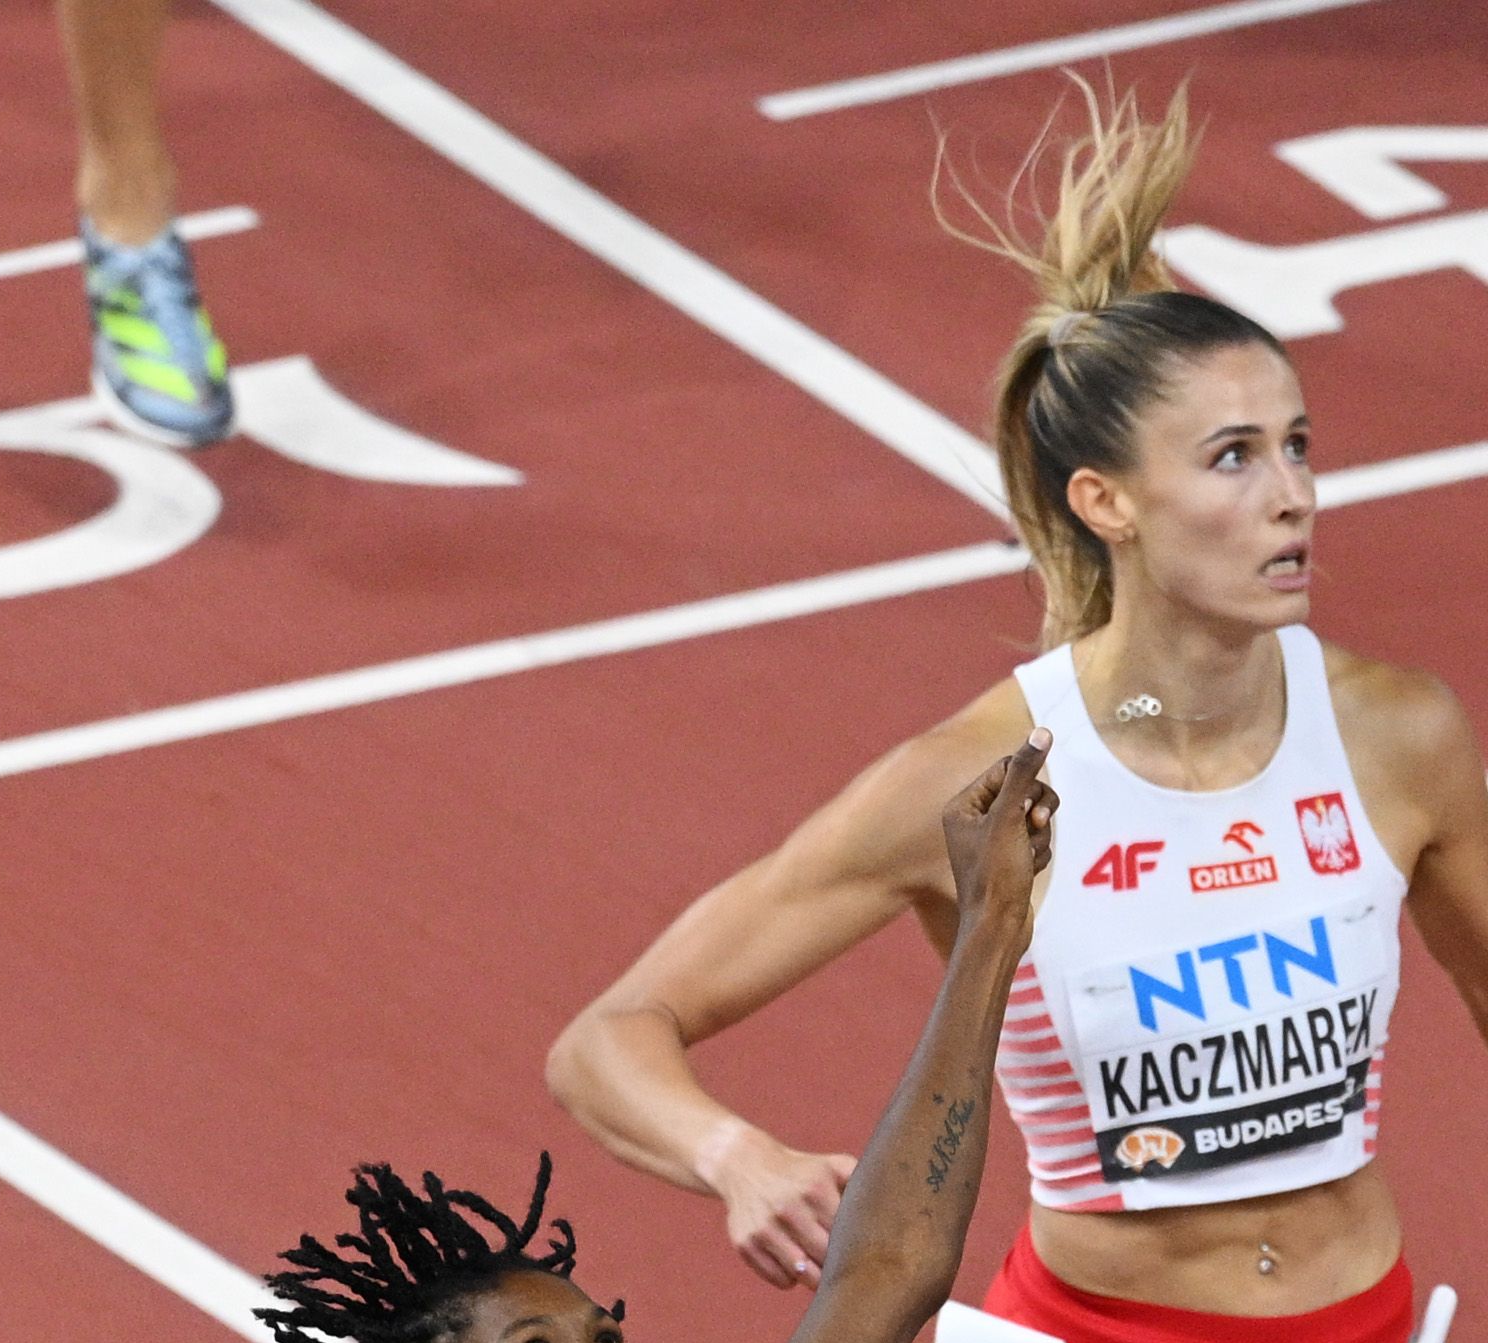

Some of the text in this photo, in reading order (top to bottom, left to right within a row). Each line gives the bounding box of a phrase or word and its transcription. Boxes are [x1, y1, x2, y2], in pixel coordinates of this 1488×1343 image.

[1081, 841, 1165, 891] 4F
[1193, 859, 1274, 890] ORLEN
[1129, 916, 1338, 1032] NTN
[1099, 988, 1377, 1119] KACZMAREK
